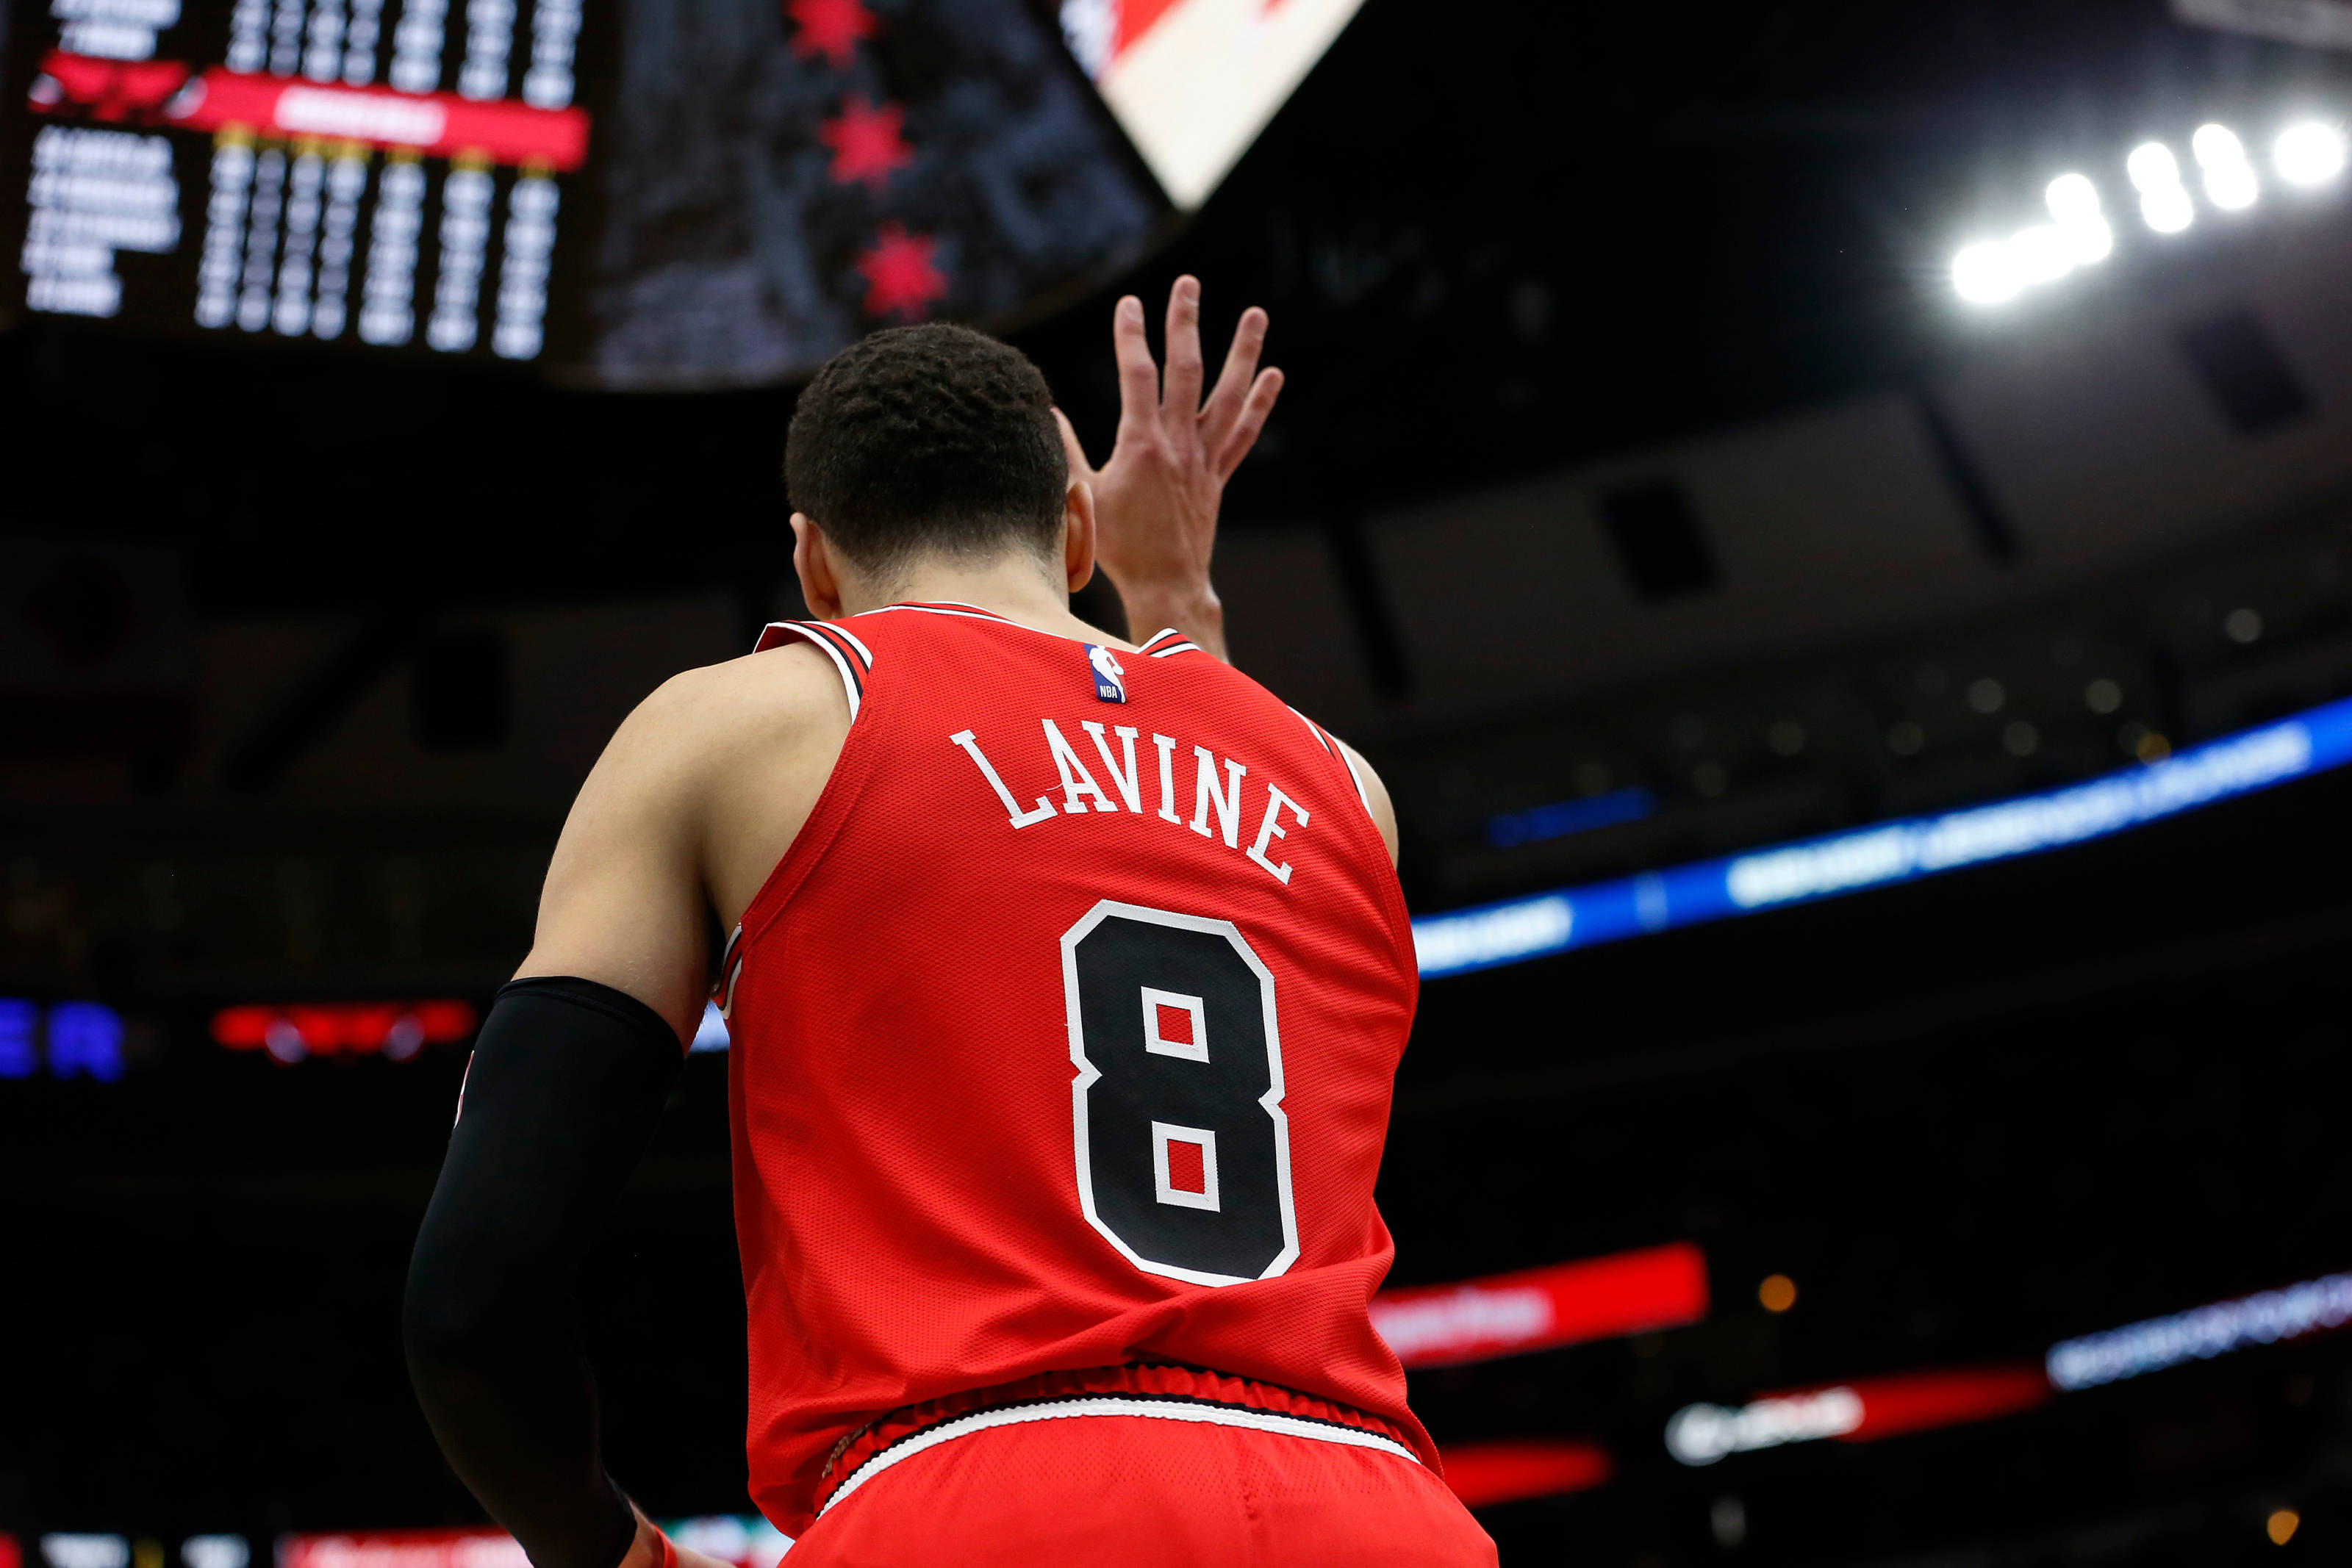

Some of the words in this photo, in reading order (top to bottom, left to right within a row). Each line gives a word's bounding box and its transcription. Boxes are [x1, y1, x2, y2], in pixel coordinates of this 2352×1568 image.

[1099, 685, 1117, 699] NBA
[949, 719, 1311, 885] LAVINE
[1060, 899, 1300, 1288] 8
